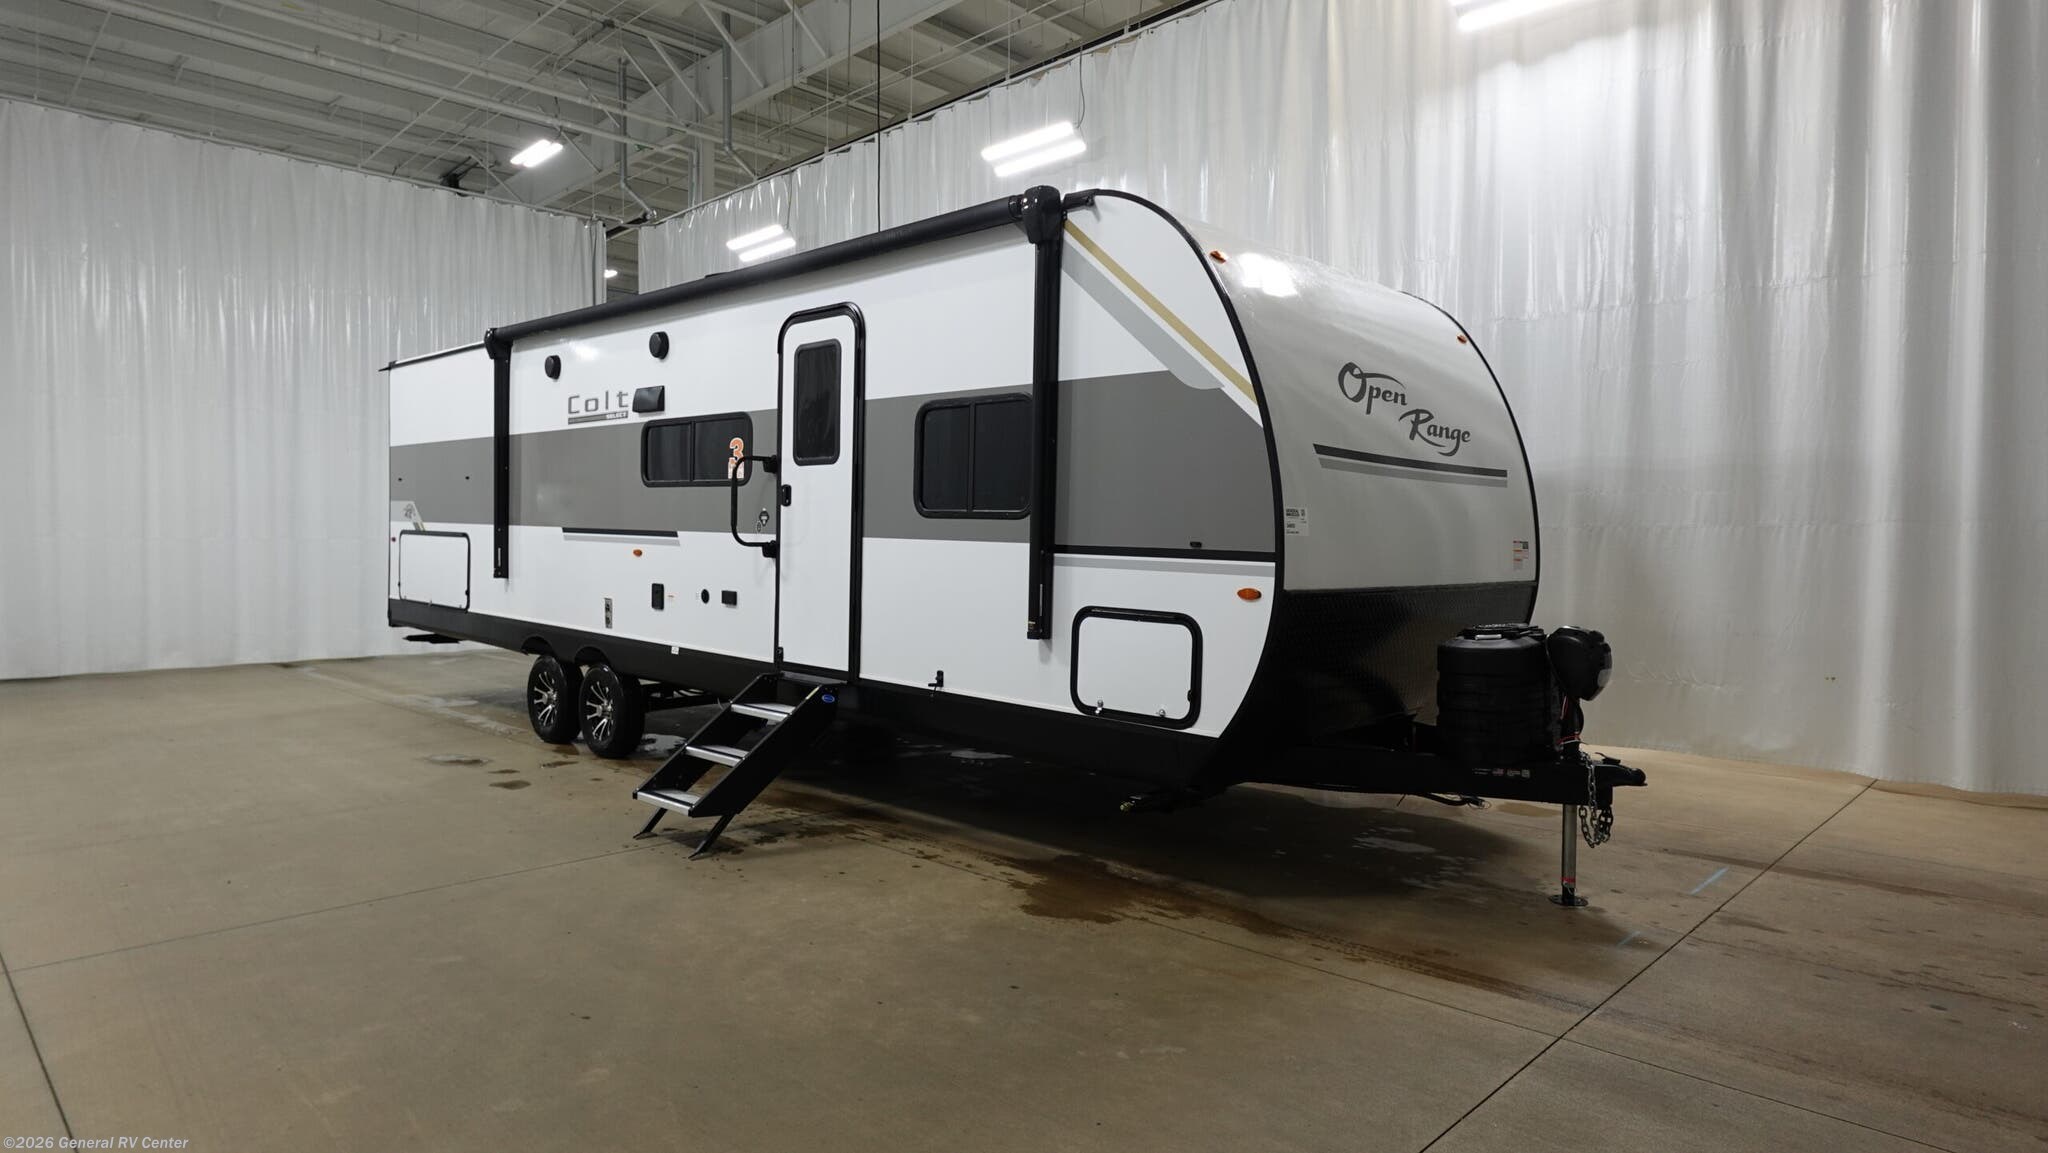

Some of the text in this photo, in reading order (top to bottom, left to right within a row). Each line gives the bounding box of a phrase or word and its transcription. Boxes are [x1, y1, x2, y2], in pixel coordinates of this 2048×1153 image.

[567, 390, 629, 415] Colt
[1338, 361, 1408, 415] Open
[1398, 408, 1472, 457] Range
